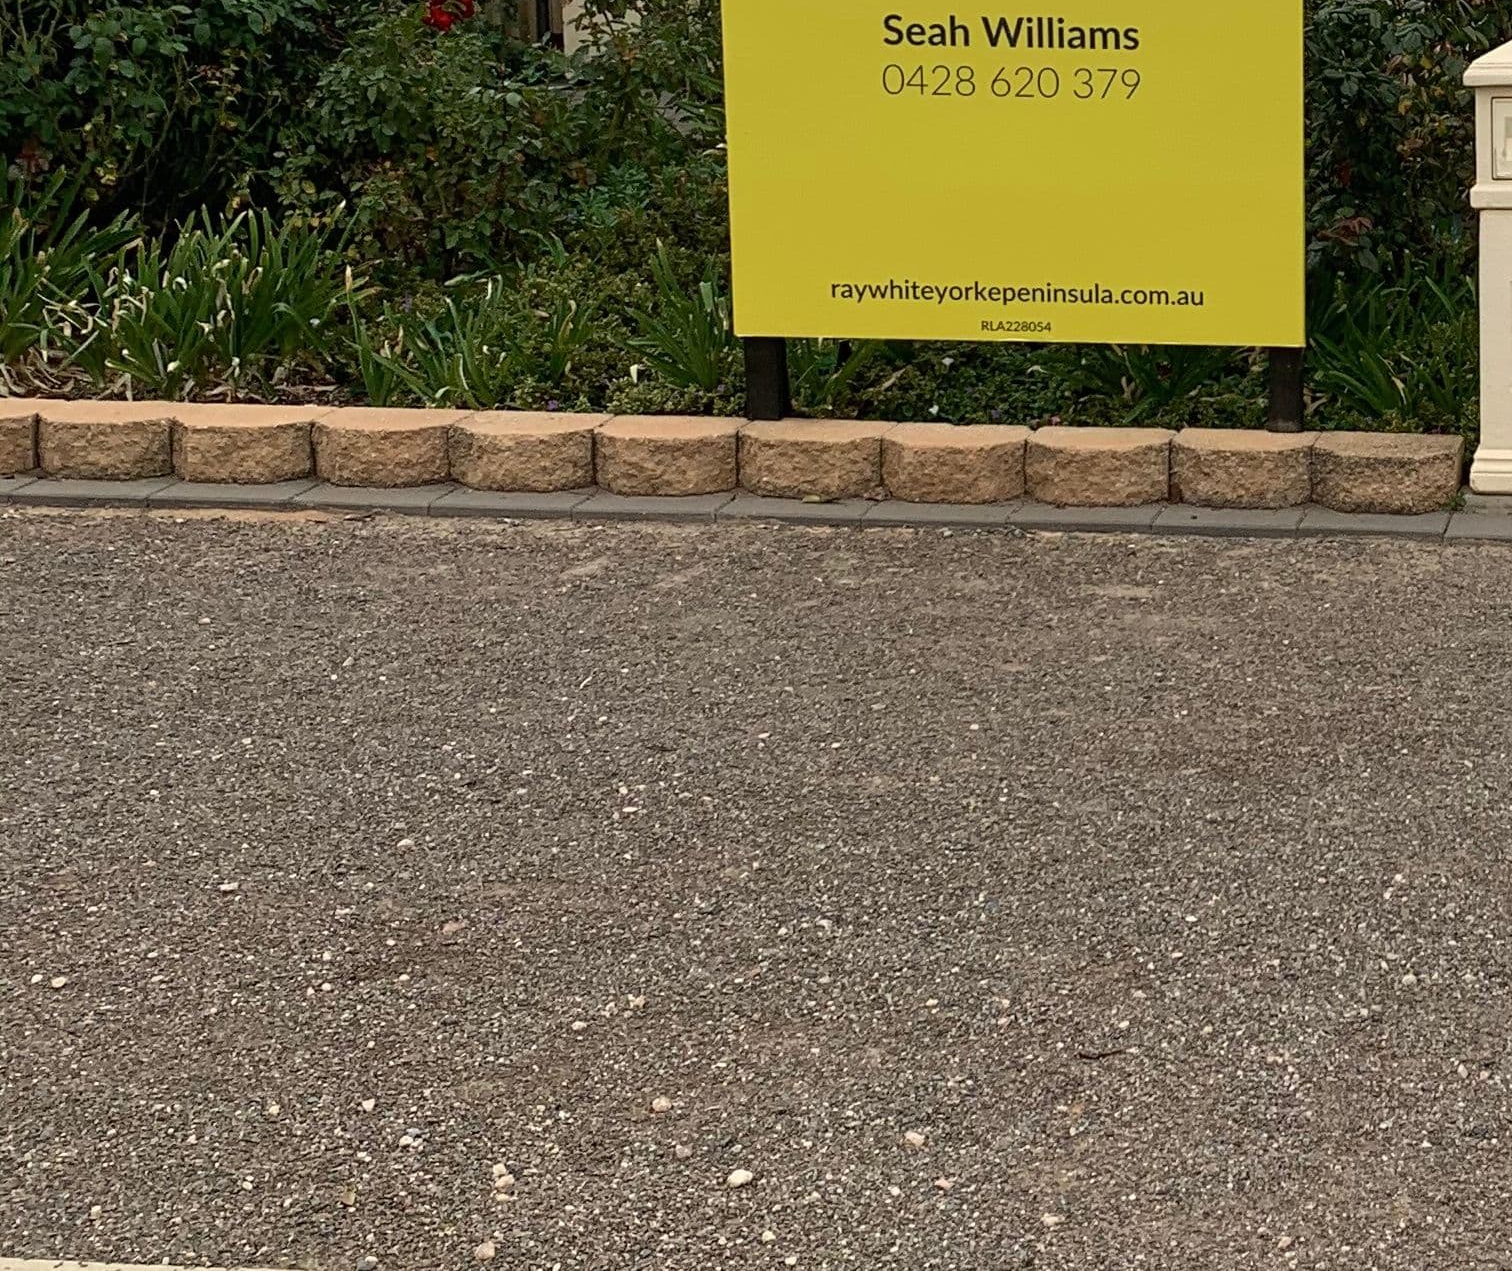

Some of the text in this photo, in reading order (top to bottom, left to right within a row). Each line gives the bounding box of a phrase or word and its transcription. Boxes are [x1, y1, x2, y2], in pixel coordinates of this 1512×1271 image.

[882, 14, 1140, 51] Seah Williams
[881, 63, 1142, 100] 0428 620 379
[831, 278, 1204, 307] raywhiteyorkepeninsula.com.au
[980, 320, 1052, 333] RLA228054
